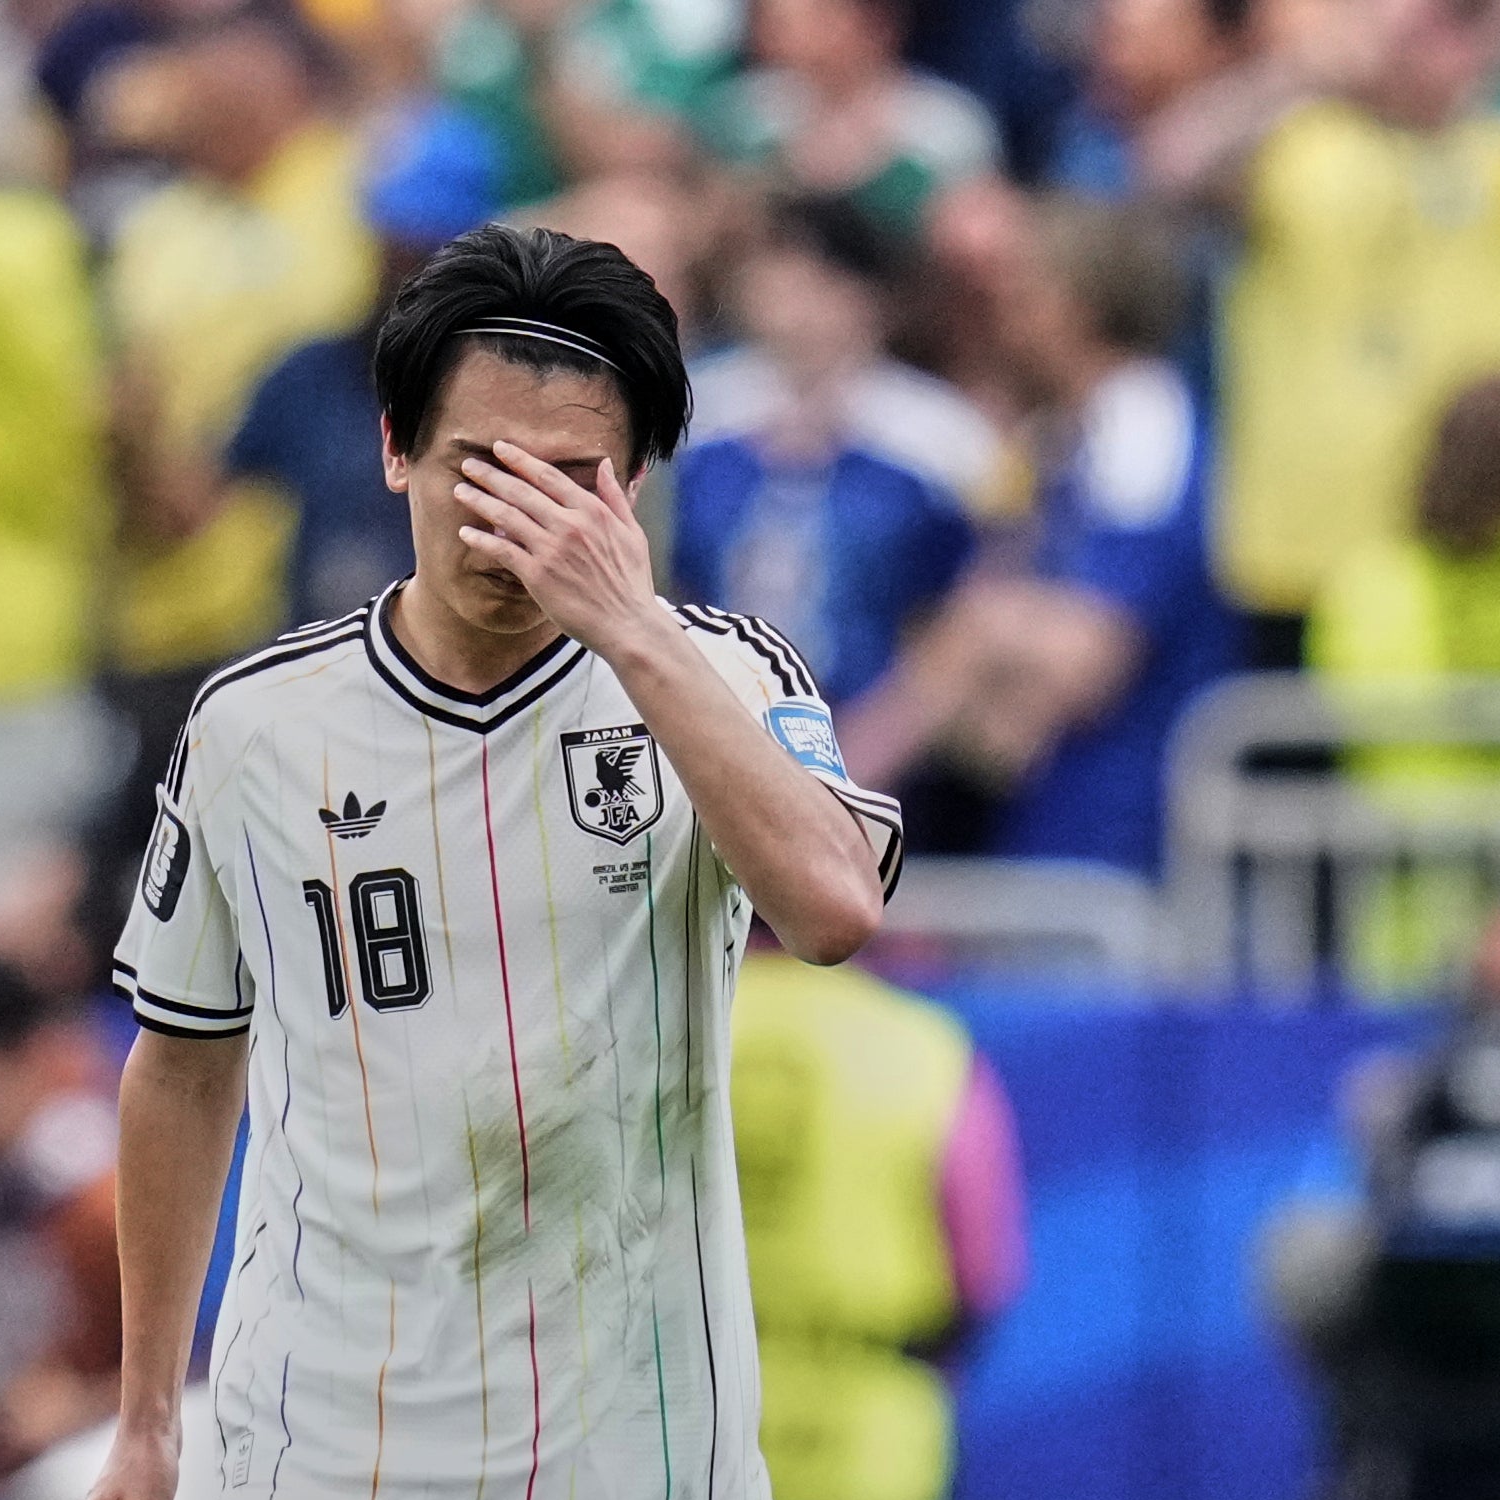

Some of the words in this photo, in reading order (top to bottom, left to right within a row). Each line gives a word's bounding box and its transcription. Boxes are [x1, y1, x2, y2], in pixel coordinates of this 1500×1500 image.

[583, 727, 633, 743] JAPAN
[598, 804, 641, 827] JFA
[302, 867, 434, 1020] 18
